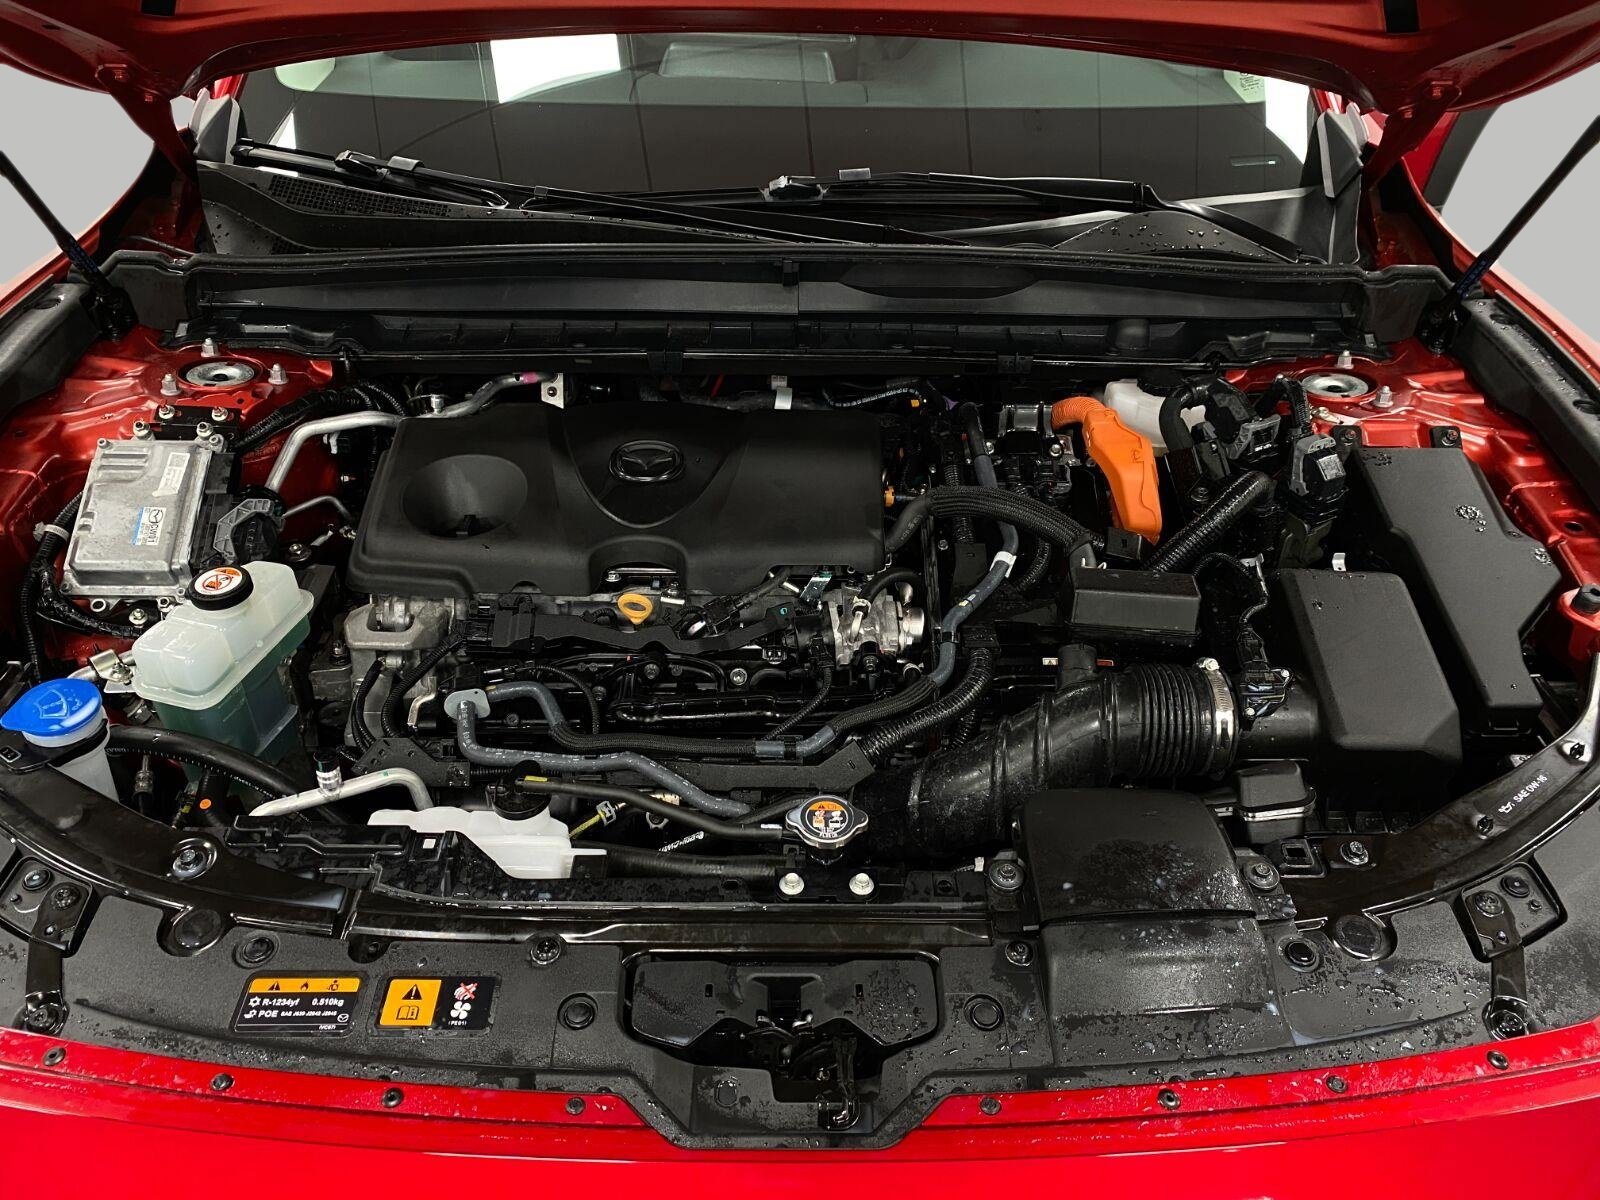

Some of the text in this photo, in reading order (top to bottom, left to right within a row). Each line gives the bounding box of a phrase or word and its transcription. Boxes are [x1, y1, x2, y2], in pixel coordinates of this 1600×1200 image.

[1513, 775, 1547, 802] SAE 0W-16
[262, 998, 345, 1007] R-1234yf 0.510kg
[258, 1010, 279, 1018] POE
